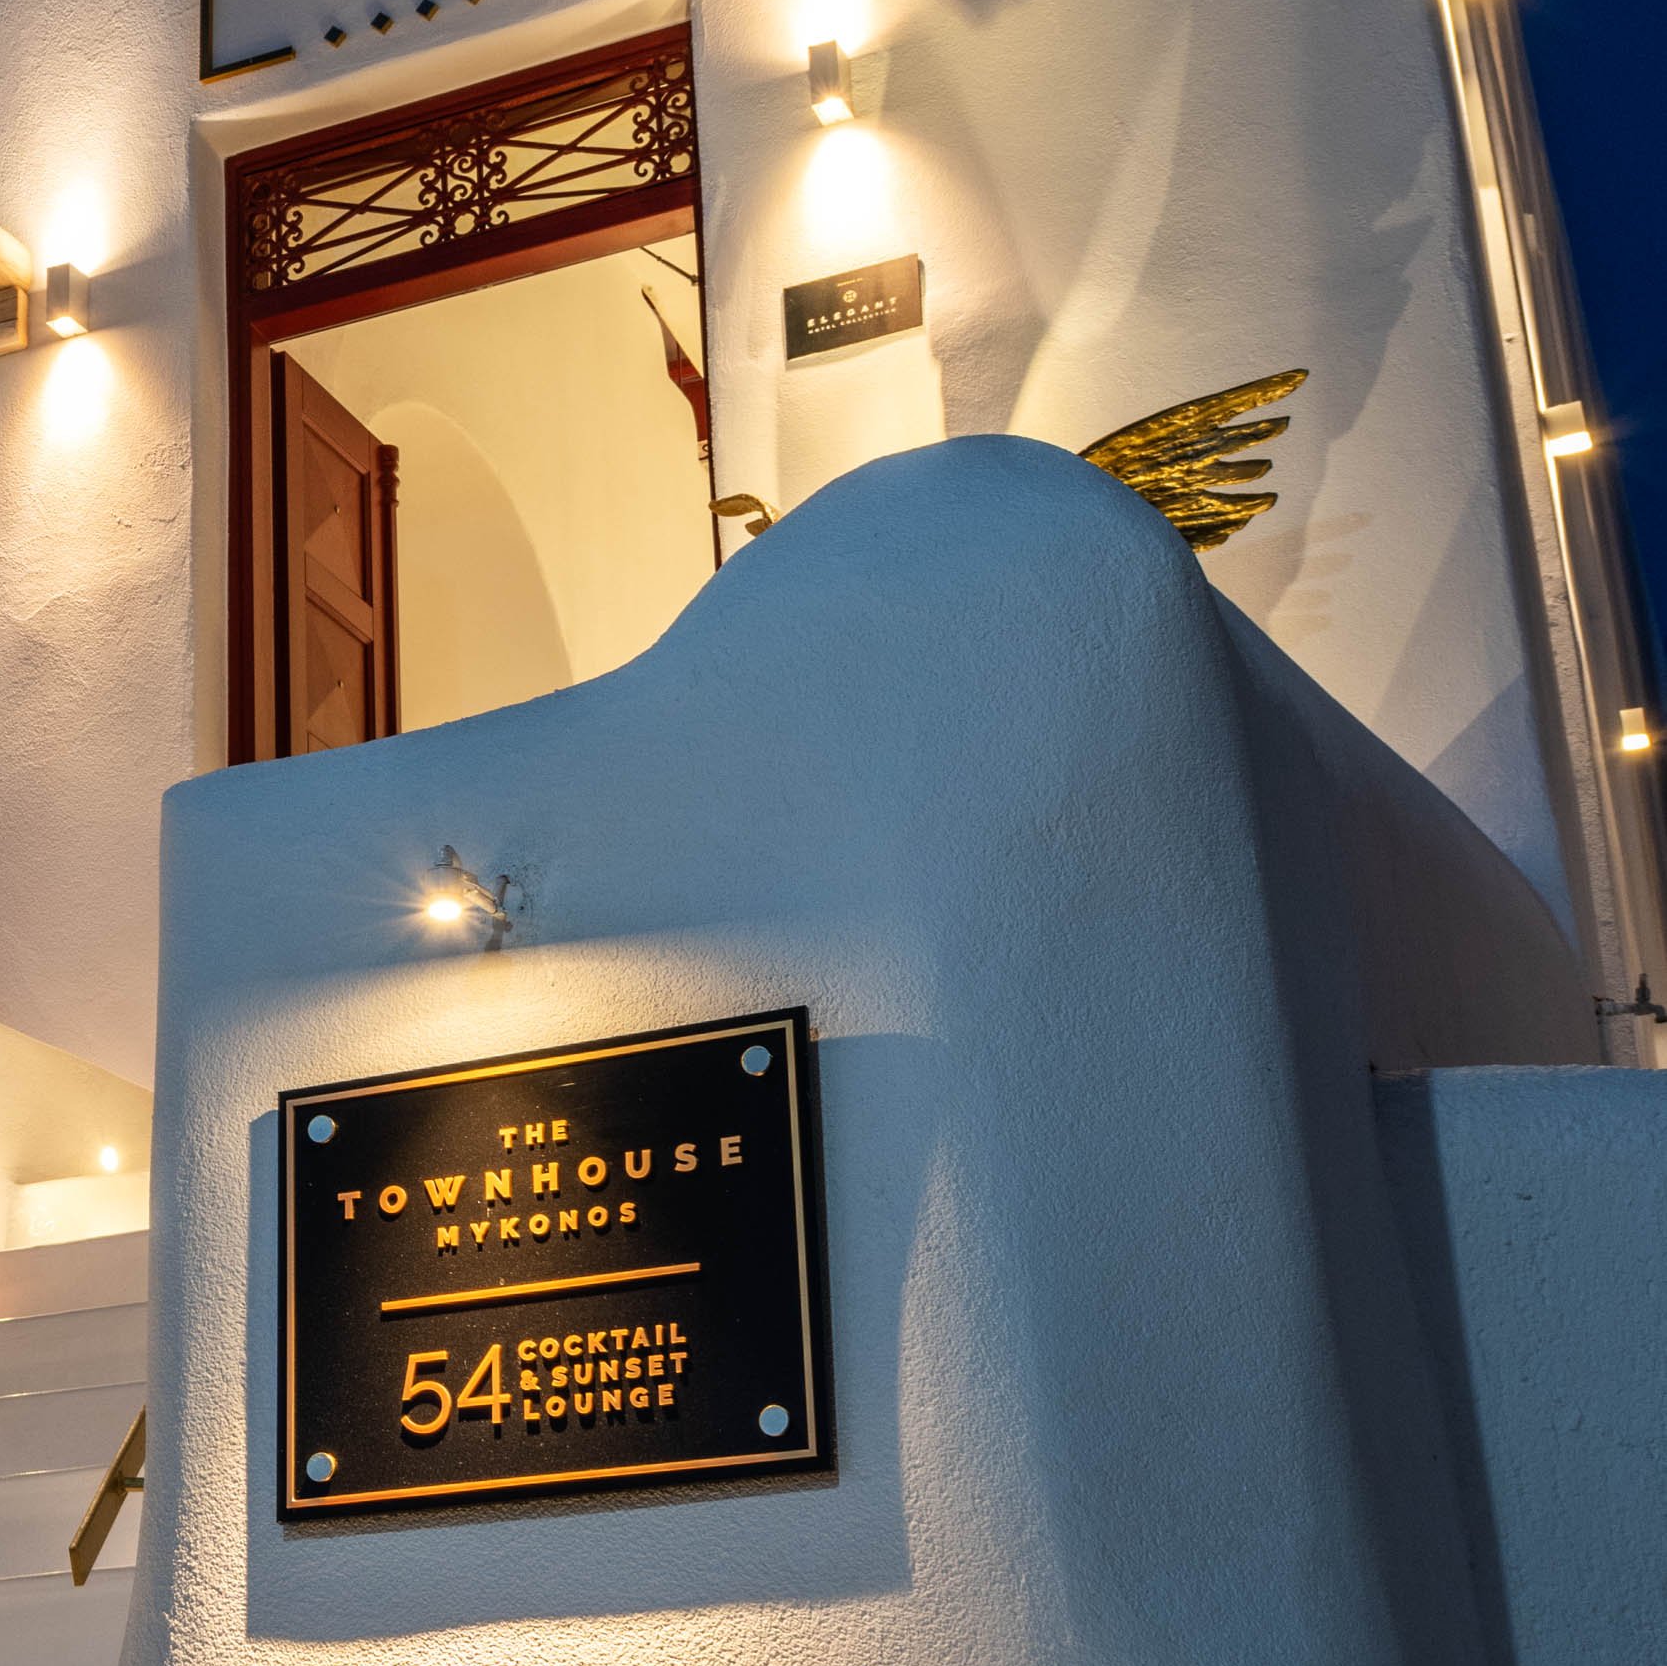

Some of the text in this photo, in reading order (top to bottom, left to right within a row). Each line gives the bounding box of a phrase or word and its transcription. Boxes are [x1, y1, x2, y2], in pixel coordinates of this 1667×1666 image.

[806, 296, 897, 328] ELEGANT
[499, 1119, 569, 1150] THE
[337, 1135, 743, 1220] TOWNHOUSE
[437, 1202, 636, 1249] MYKONOS
[517, 1323, 687, 1362] COCKTAIL
[400, 1344, 511, 1434] 54
[520, 1352, 688, 1392] & SUNSET
[524, 1384, 674, 1421] LOUNGE
